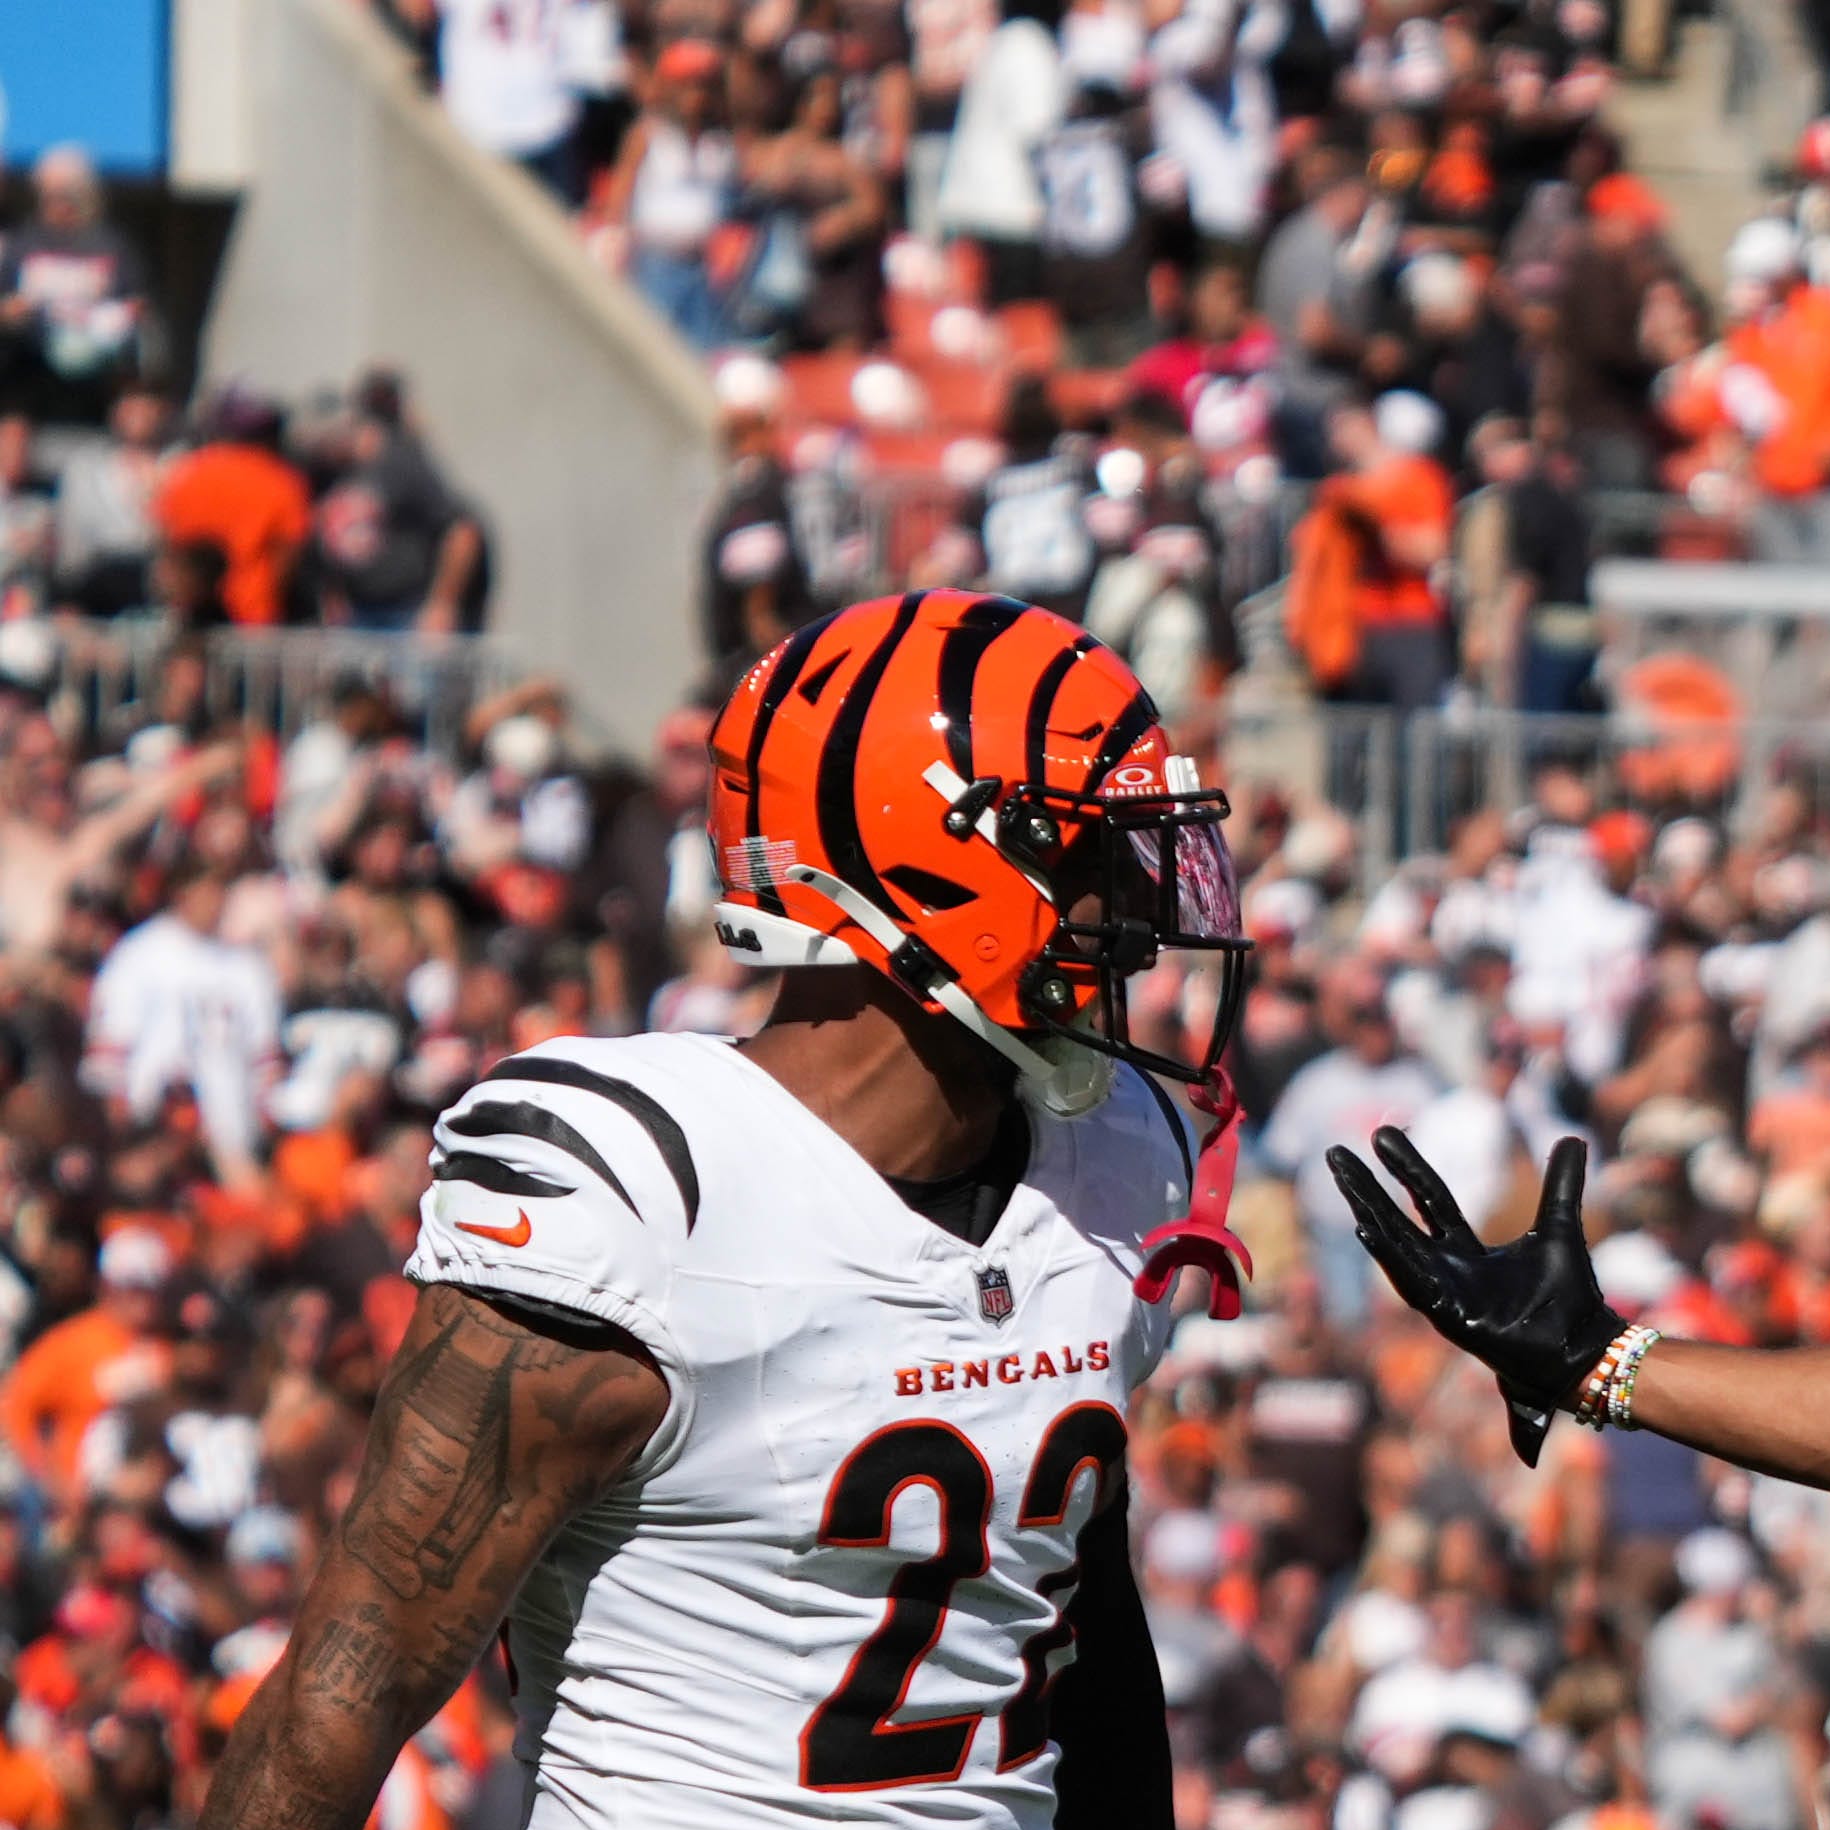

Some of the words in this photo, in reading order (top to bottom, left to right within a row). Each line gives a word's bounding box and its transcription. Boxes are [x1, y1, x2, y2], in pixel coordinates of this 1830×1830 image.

[1105, 785, 1163, 796] OAKLEY
[983, 1287, 1012, 1315] NFL
[894, 1340, 1111, 1396] BENGALS
[799, 1399, 1128, 1793] 22
